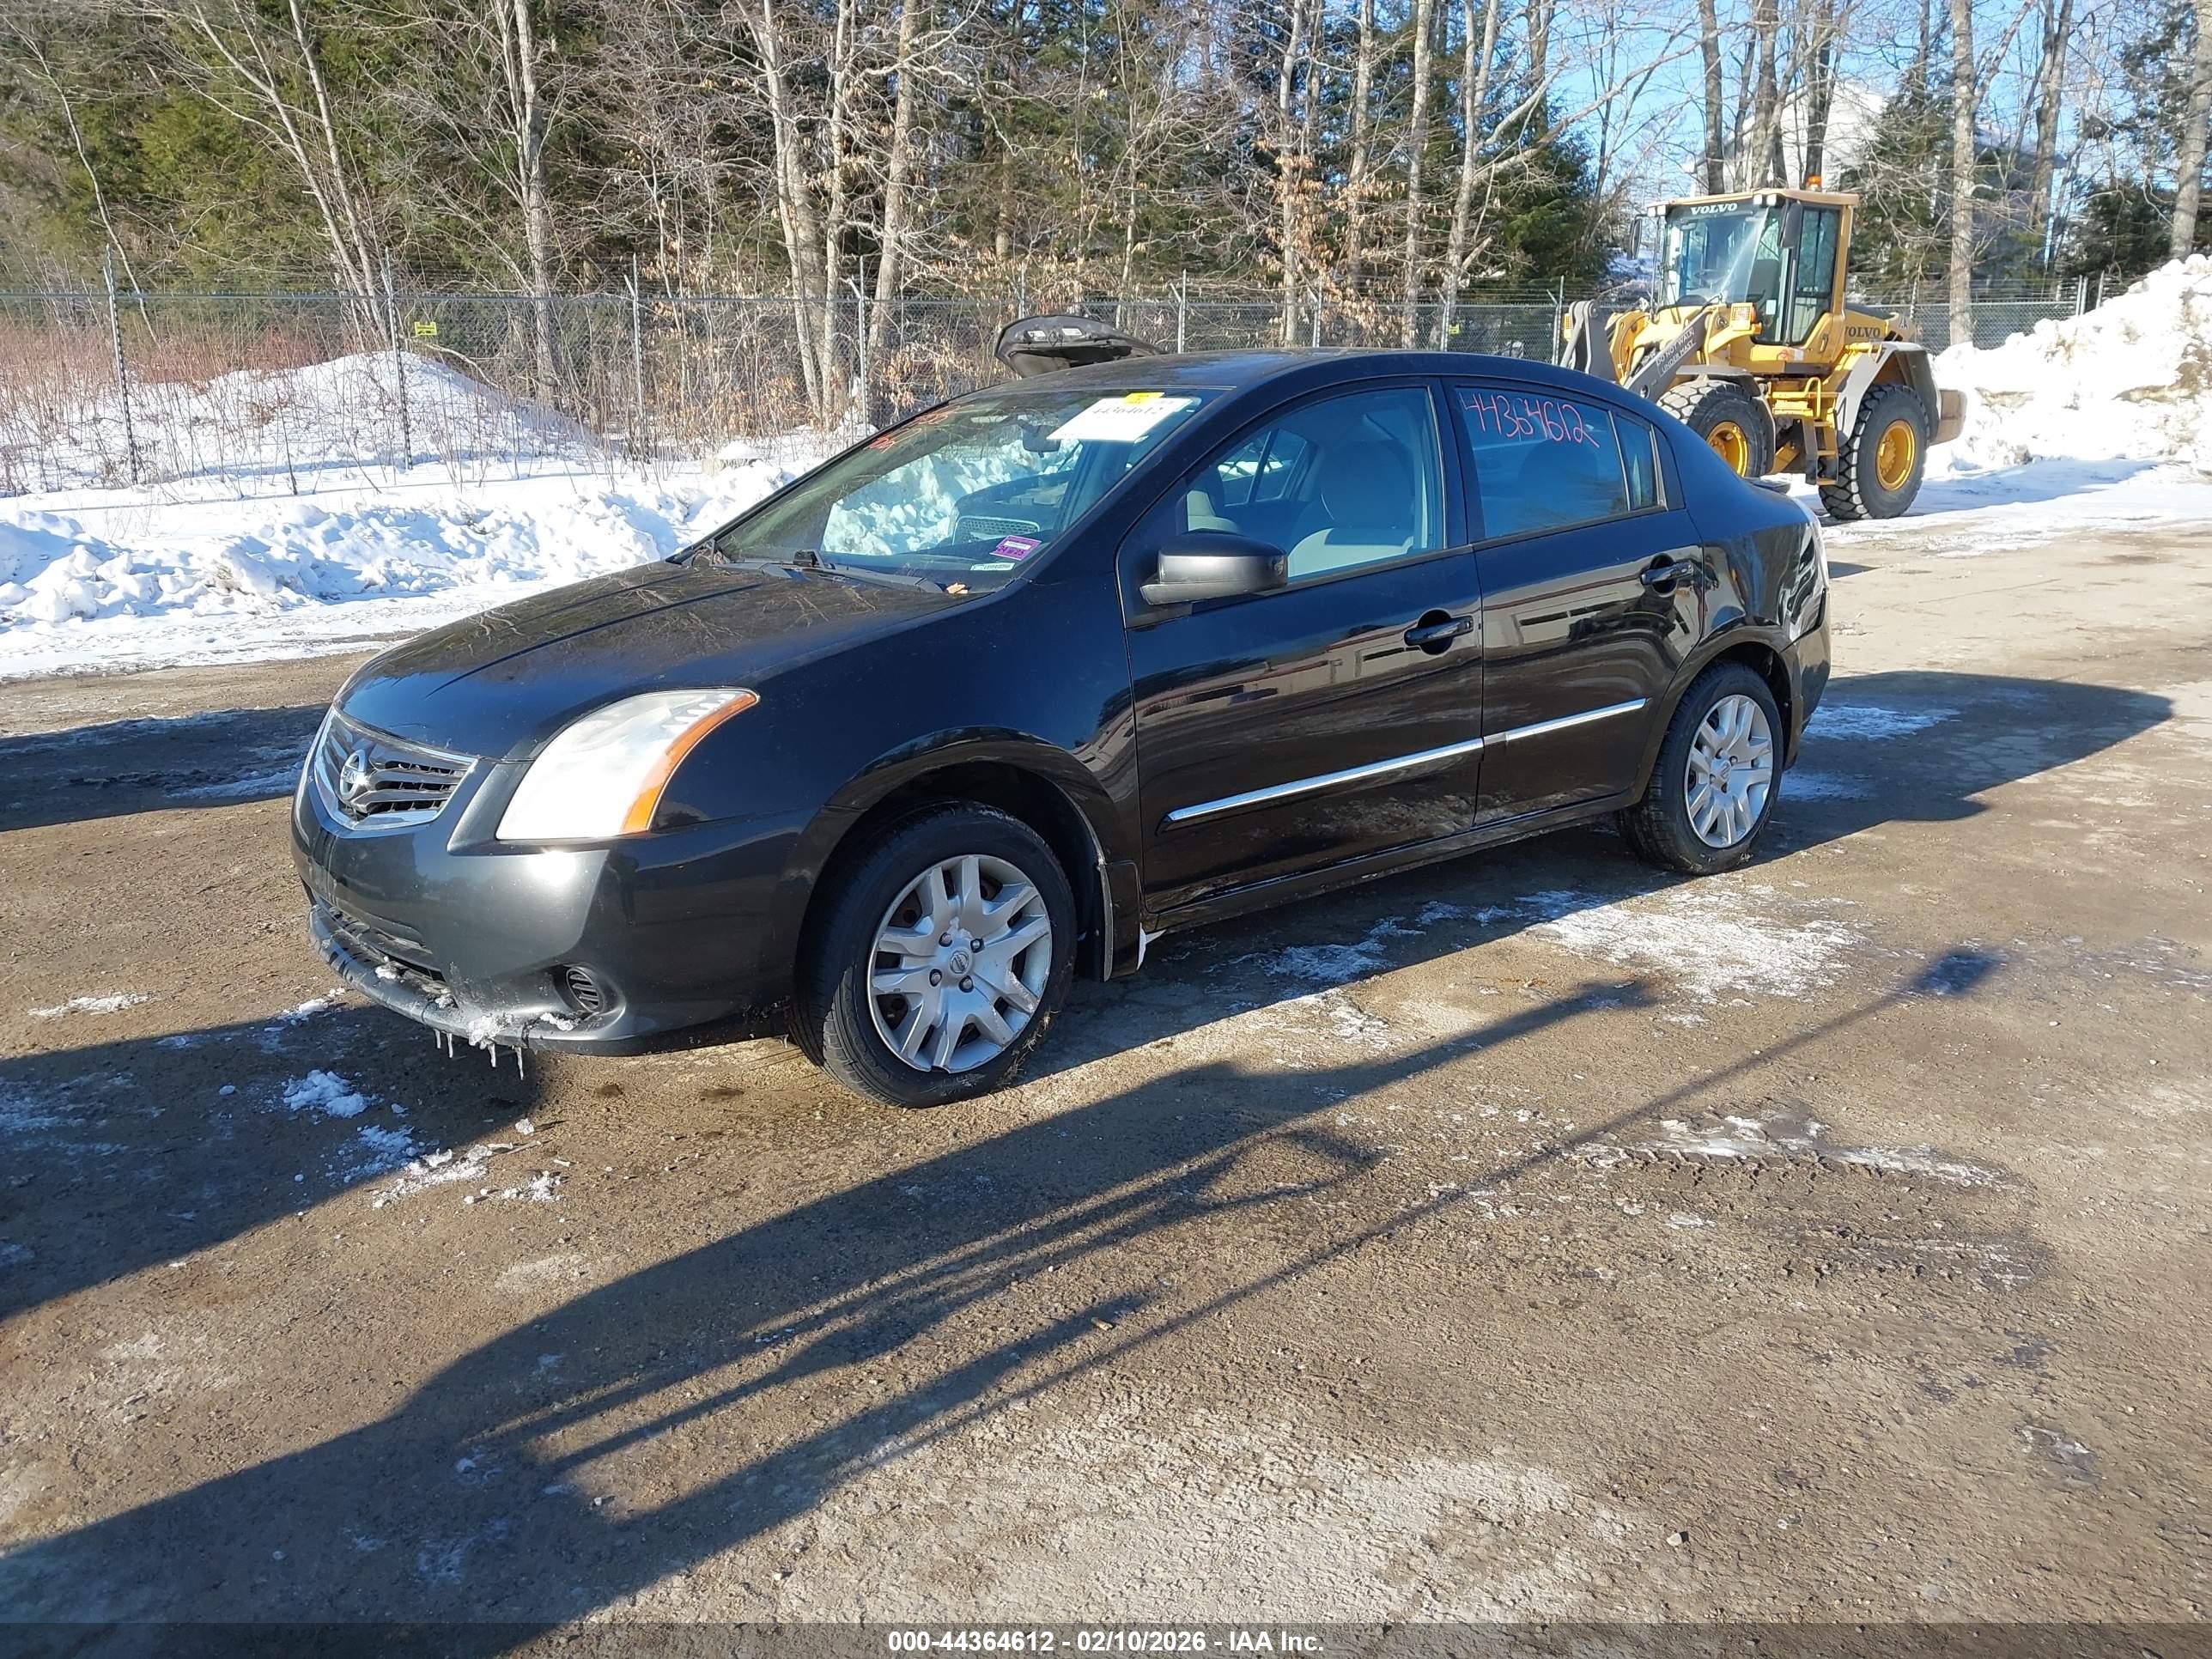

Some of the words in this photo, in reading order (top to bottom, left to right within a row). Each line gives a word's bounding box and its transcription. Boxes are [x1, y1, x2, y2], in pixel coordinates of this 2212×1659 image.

[1690, 203, 1738, 215] VOLVO
[1656, 354, 1665, 366] DO
[1665, 343, 1678, 357] NOT
[1678, 327, 1695, 346] WALK
[1662, 353, 1680, 374] UNDER
[1458, 391, 1600, 448] 44364612
